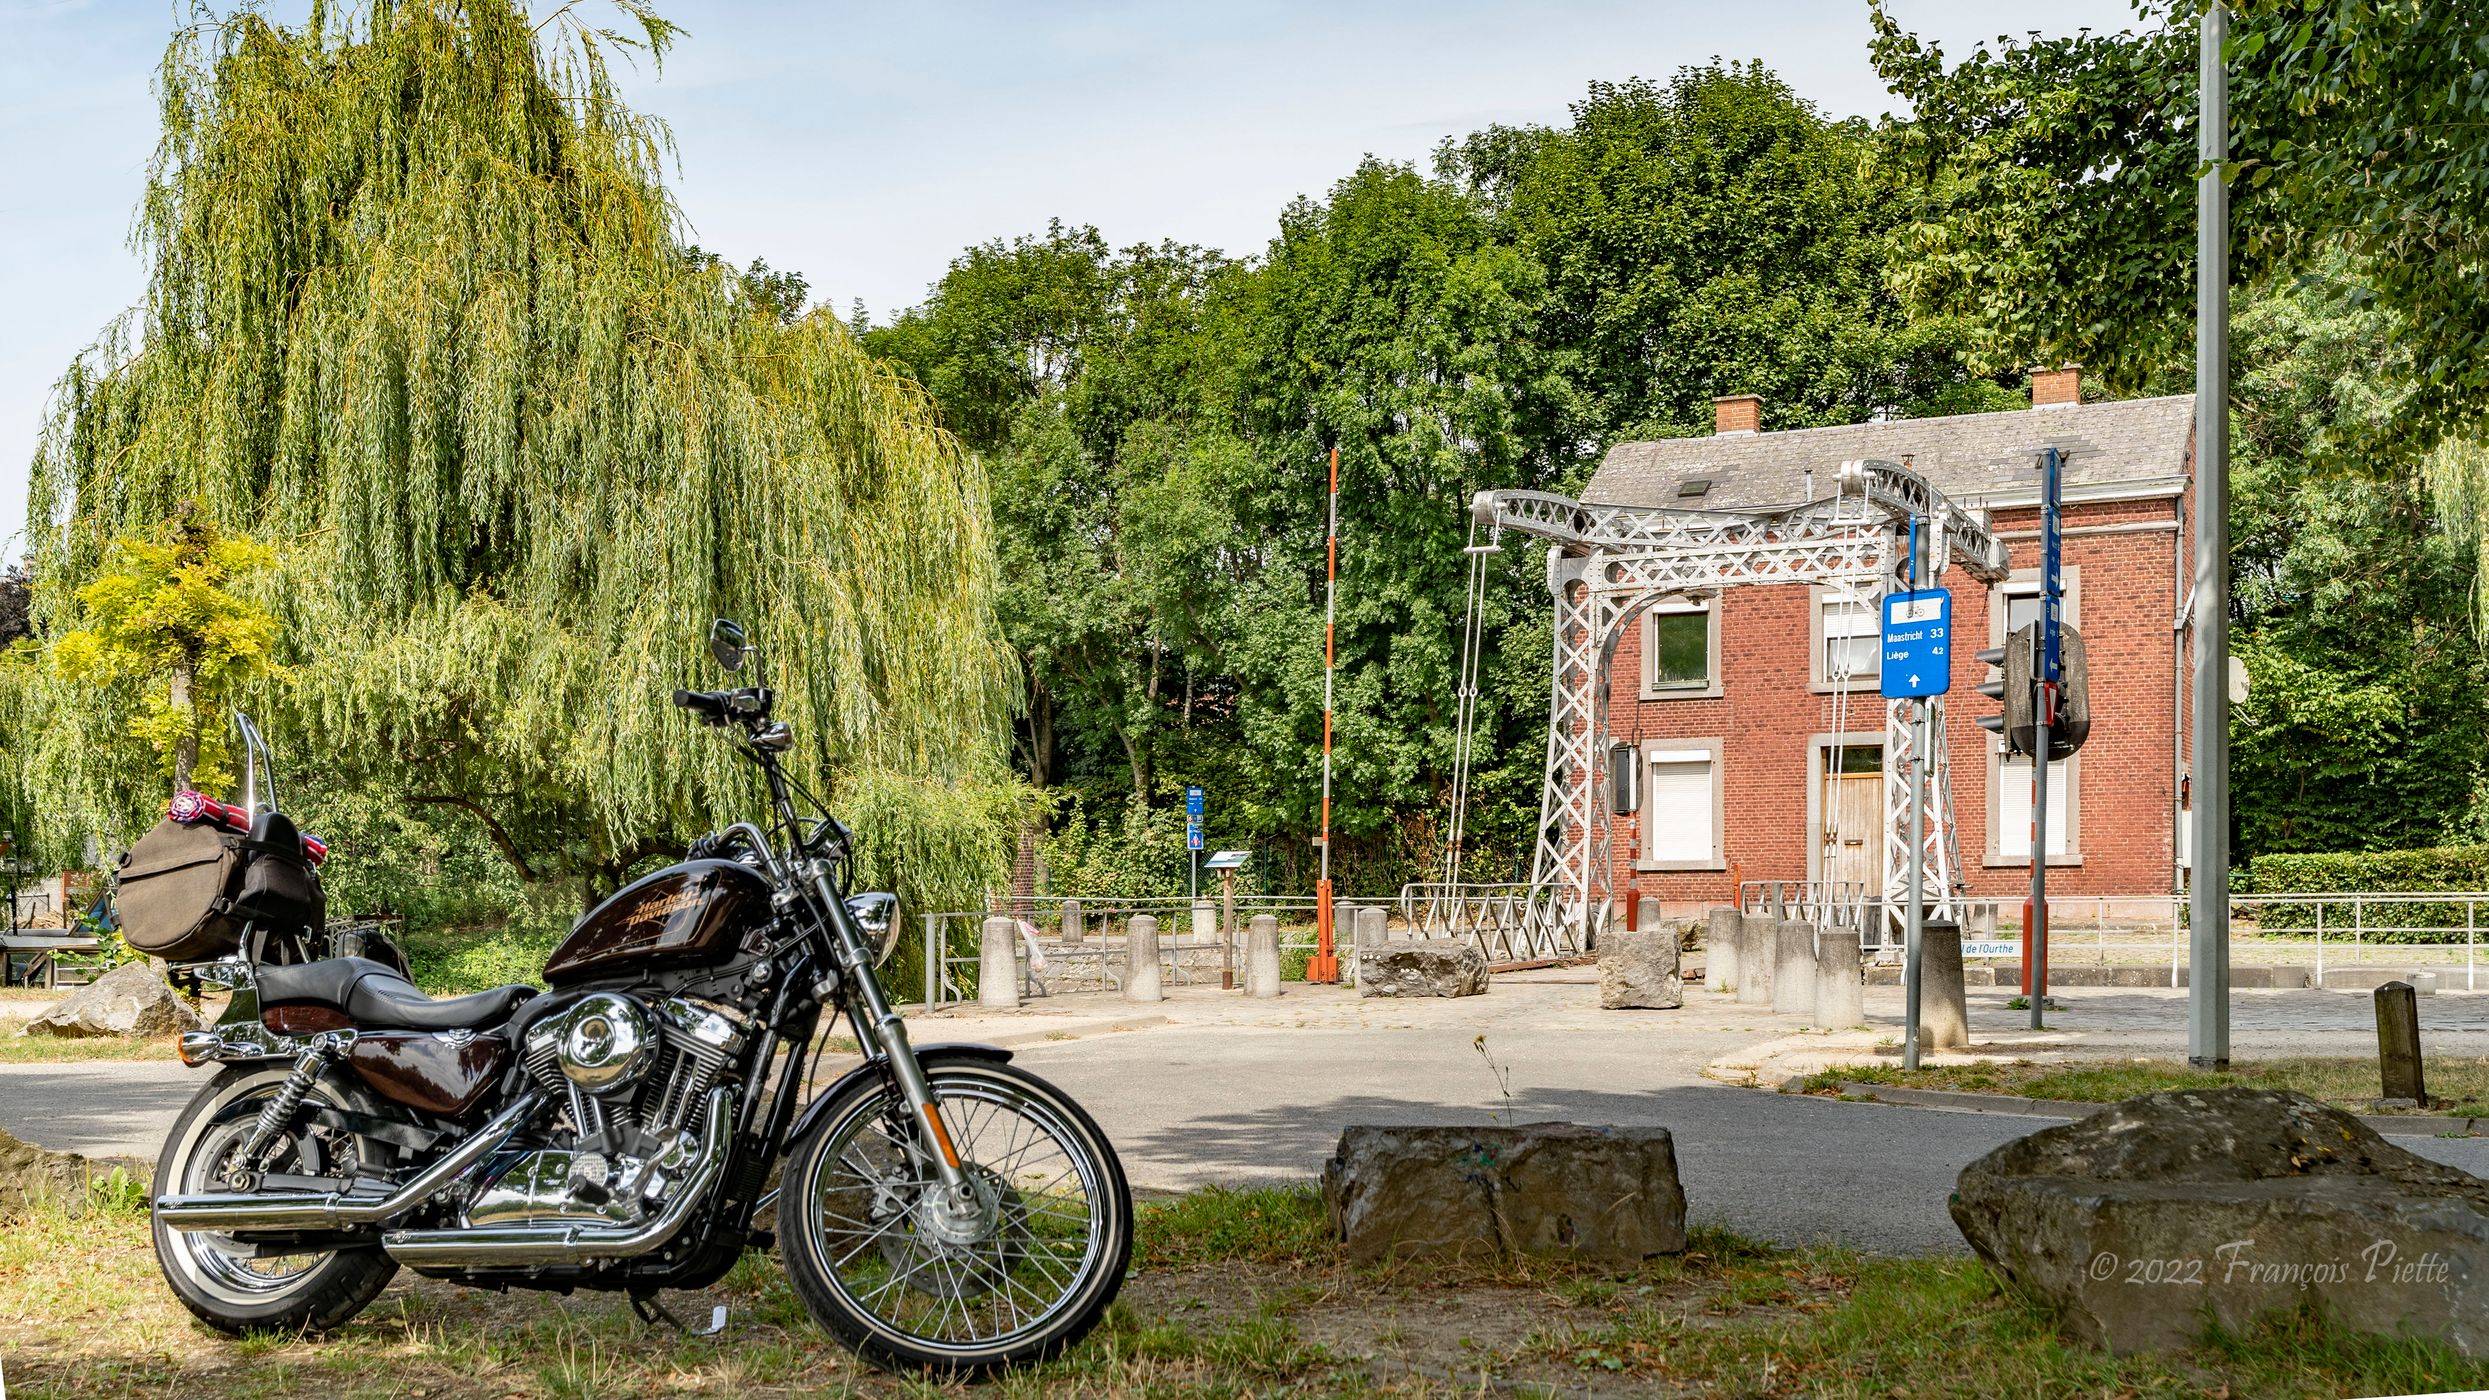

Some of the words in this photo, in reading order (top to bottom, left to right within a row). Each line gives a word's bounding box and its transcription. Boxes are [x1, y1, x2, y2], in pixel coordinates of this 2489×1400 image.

[1887, 630, 1923, 643] Maastricht
[1930, 627, 1944, 639] 33
[1887, 650, 1909, 661] Liège
[1932, 646, 1944, 655] 42
[627, 898, 705, 925] Davidson
[1966, 944, 1977, 953] de
[1979, 944, 2014, 953] l'Ourthe
